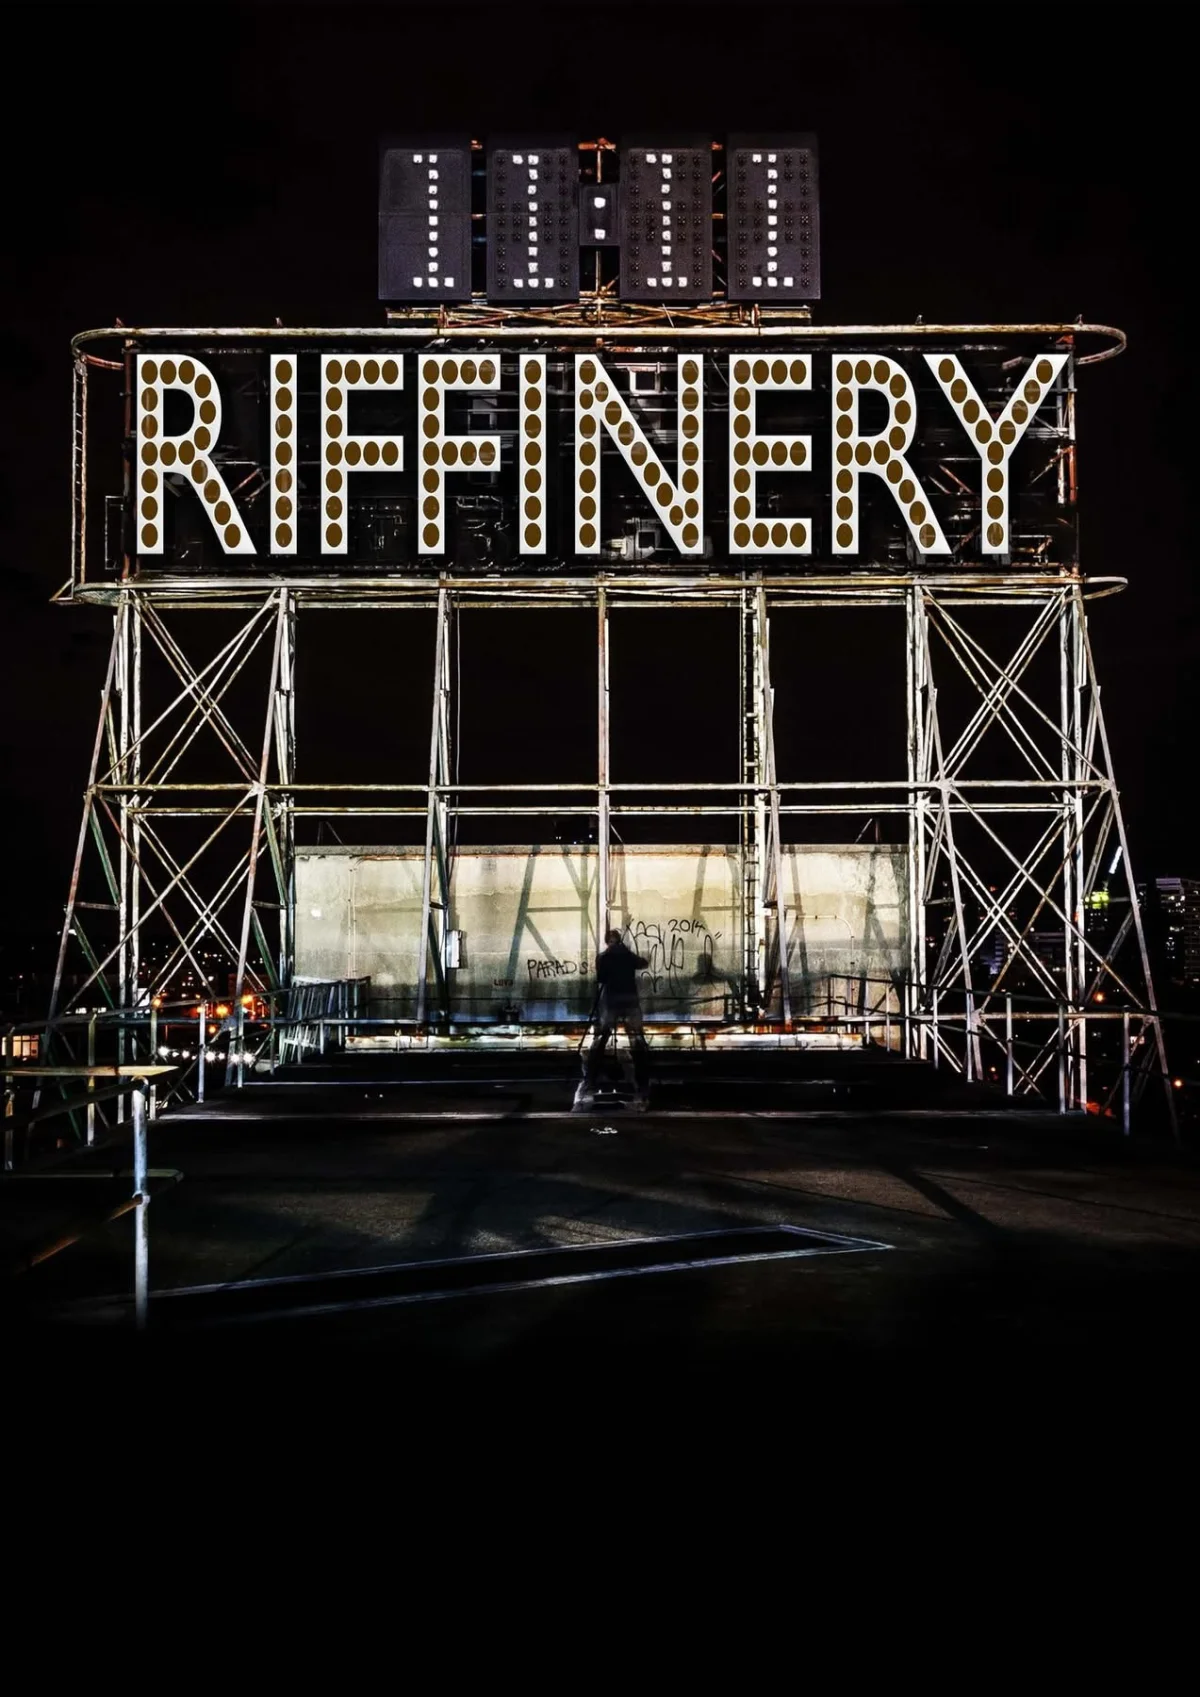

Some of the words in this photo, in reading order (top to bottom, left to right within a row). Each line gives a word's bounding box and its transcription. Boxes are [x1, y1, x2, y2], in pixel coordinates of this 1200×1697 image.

[412, 153, 794, 287] 11:11
[136, 353, 1067, 555] RIFFINERY
[668, 919, 706, 937] 2014
